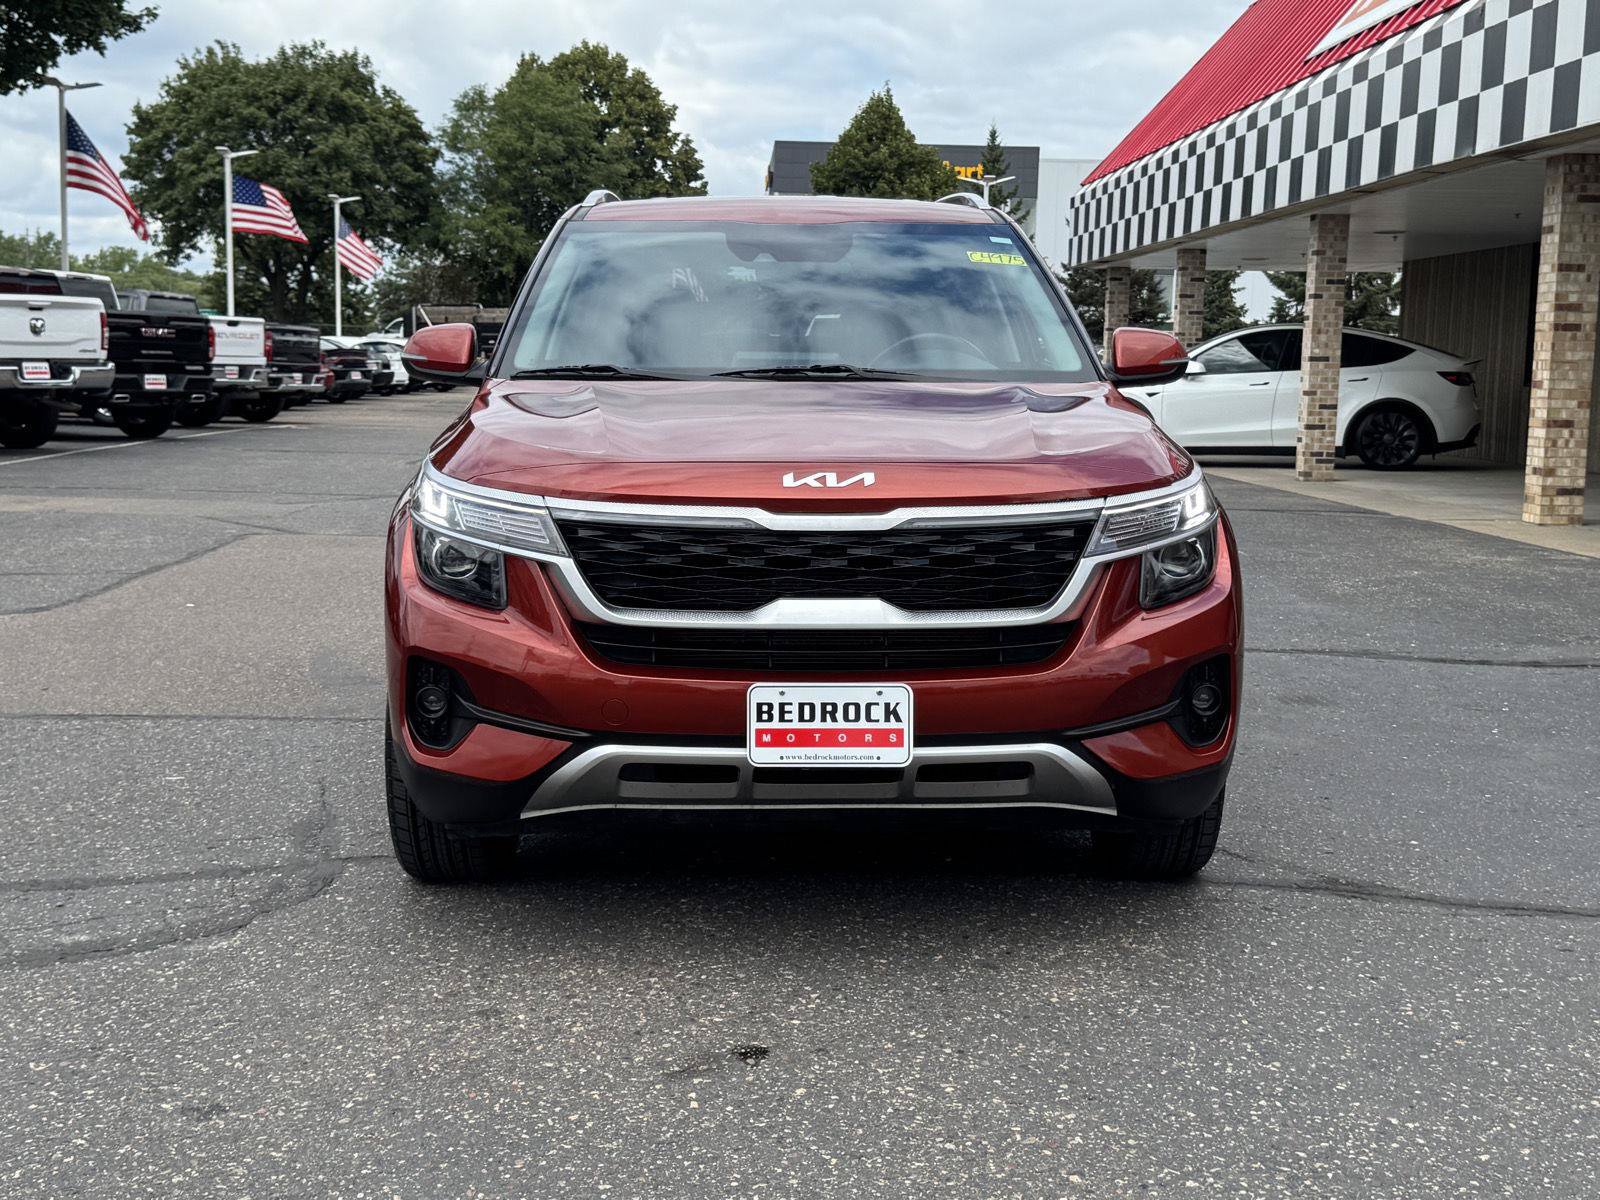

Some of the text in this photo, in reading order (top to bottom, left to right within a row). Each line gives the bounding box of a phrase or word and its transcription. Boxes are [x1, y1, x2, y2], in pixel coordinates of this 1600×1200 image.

[782, 472, 876, 488] KIA
[755, 701, 903, 723] BEDROCK
[762, 733, 897, 742] MOTORS
[785, 753, 874, 761] www.bedrockmotors.com
